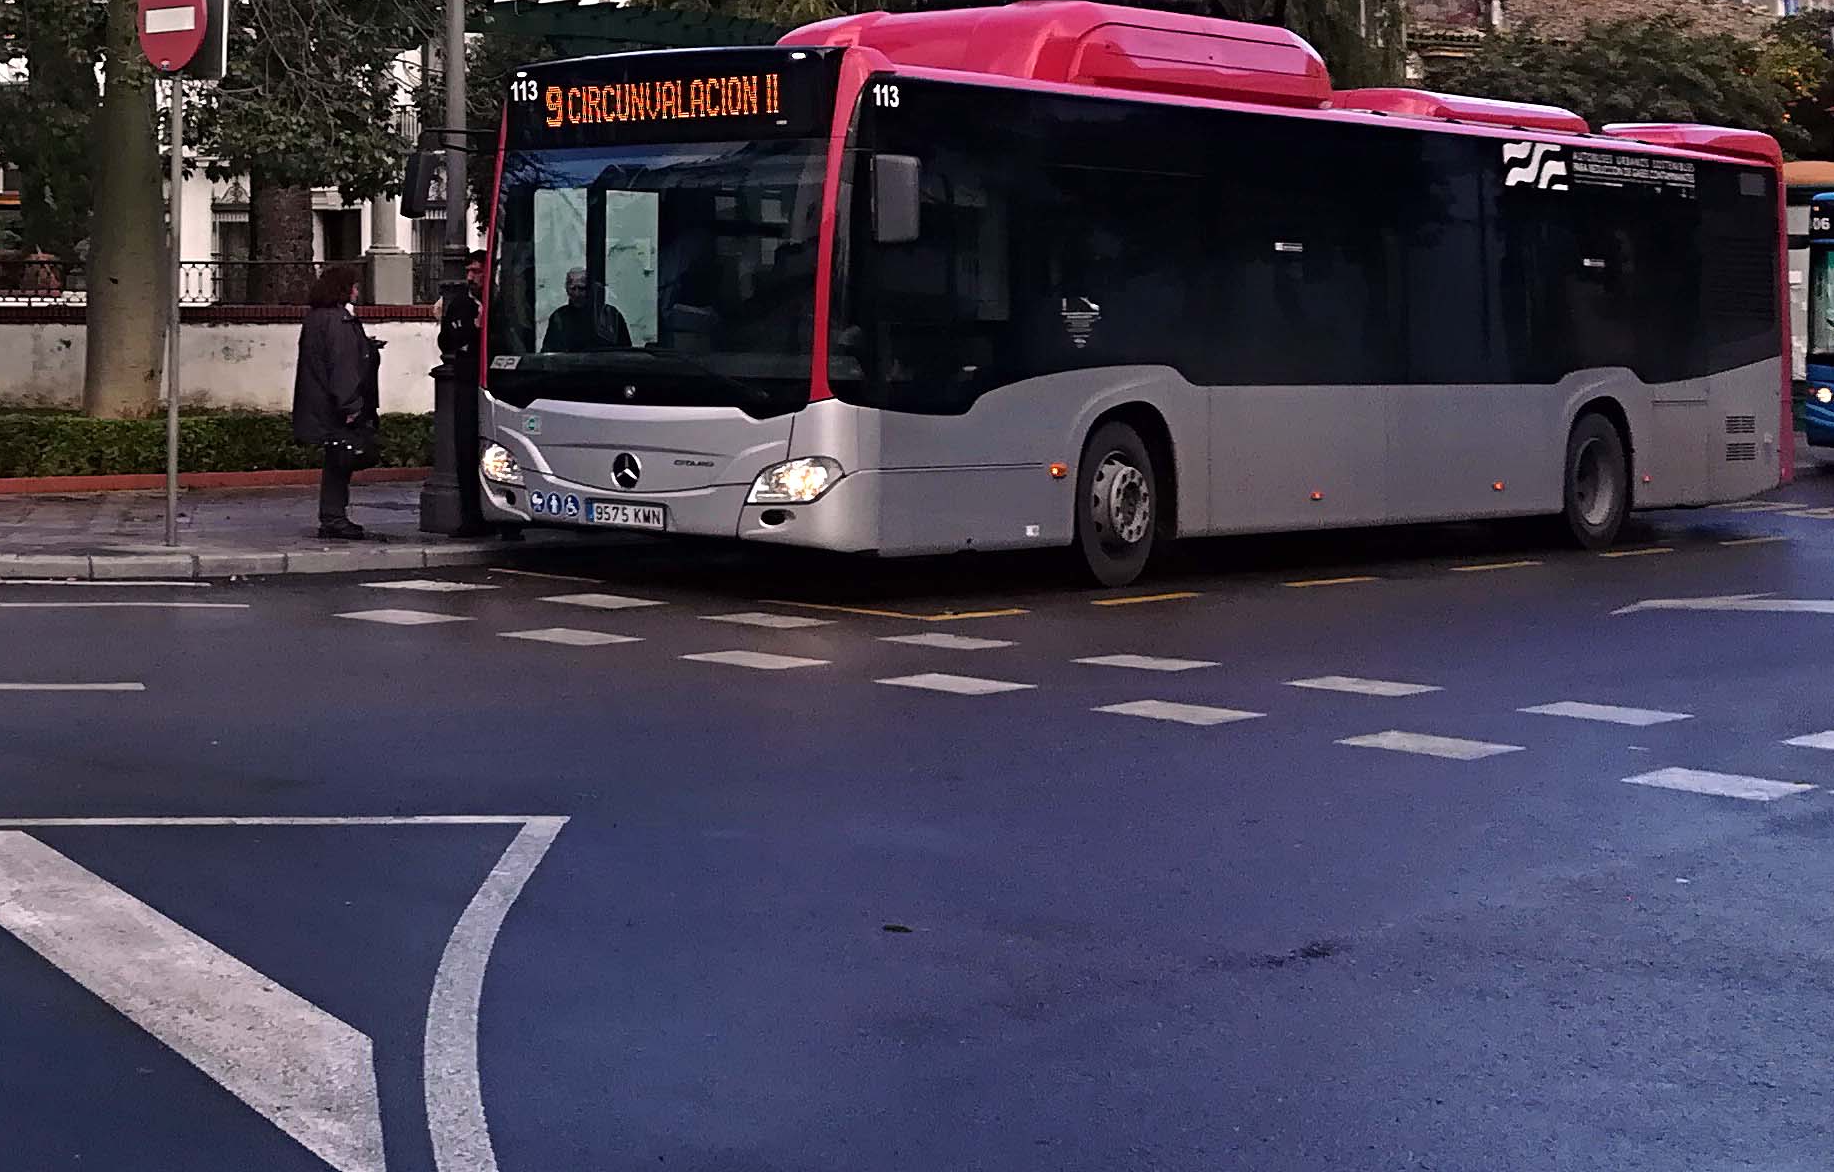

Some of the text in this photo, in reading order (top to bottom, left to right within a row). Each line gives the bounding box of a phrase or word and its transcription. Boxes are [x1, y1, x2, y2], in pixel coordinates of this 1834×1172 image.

[510, 80, 538, 101] 113
[546, 86, 563, 127] 9
[568, 75, 758, 124] CIRCUNVALACION
[872, 83, 900, 108] 113
[1809, 217, 1831, 230] 06
[595, 505, 629, 523] 9575
